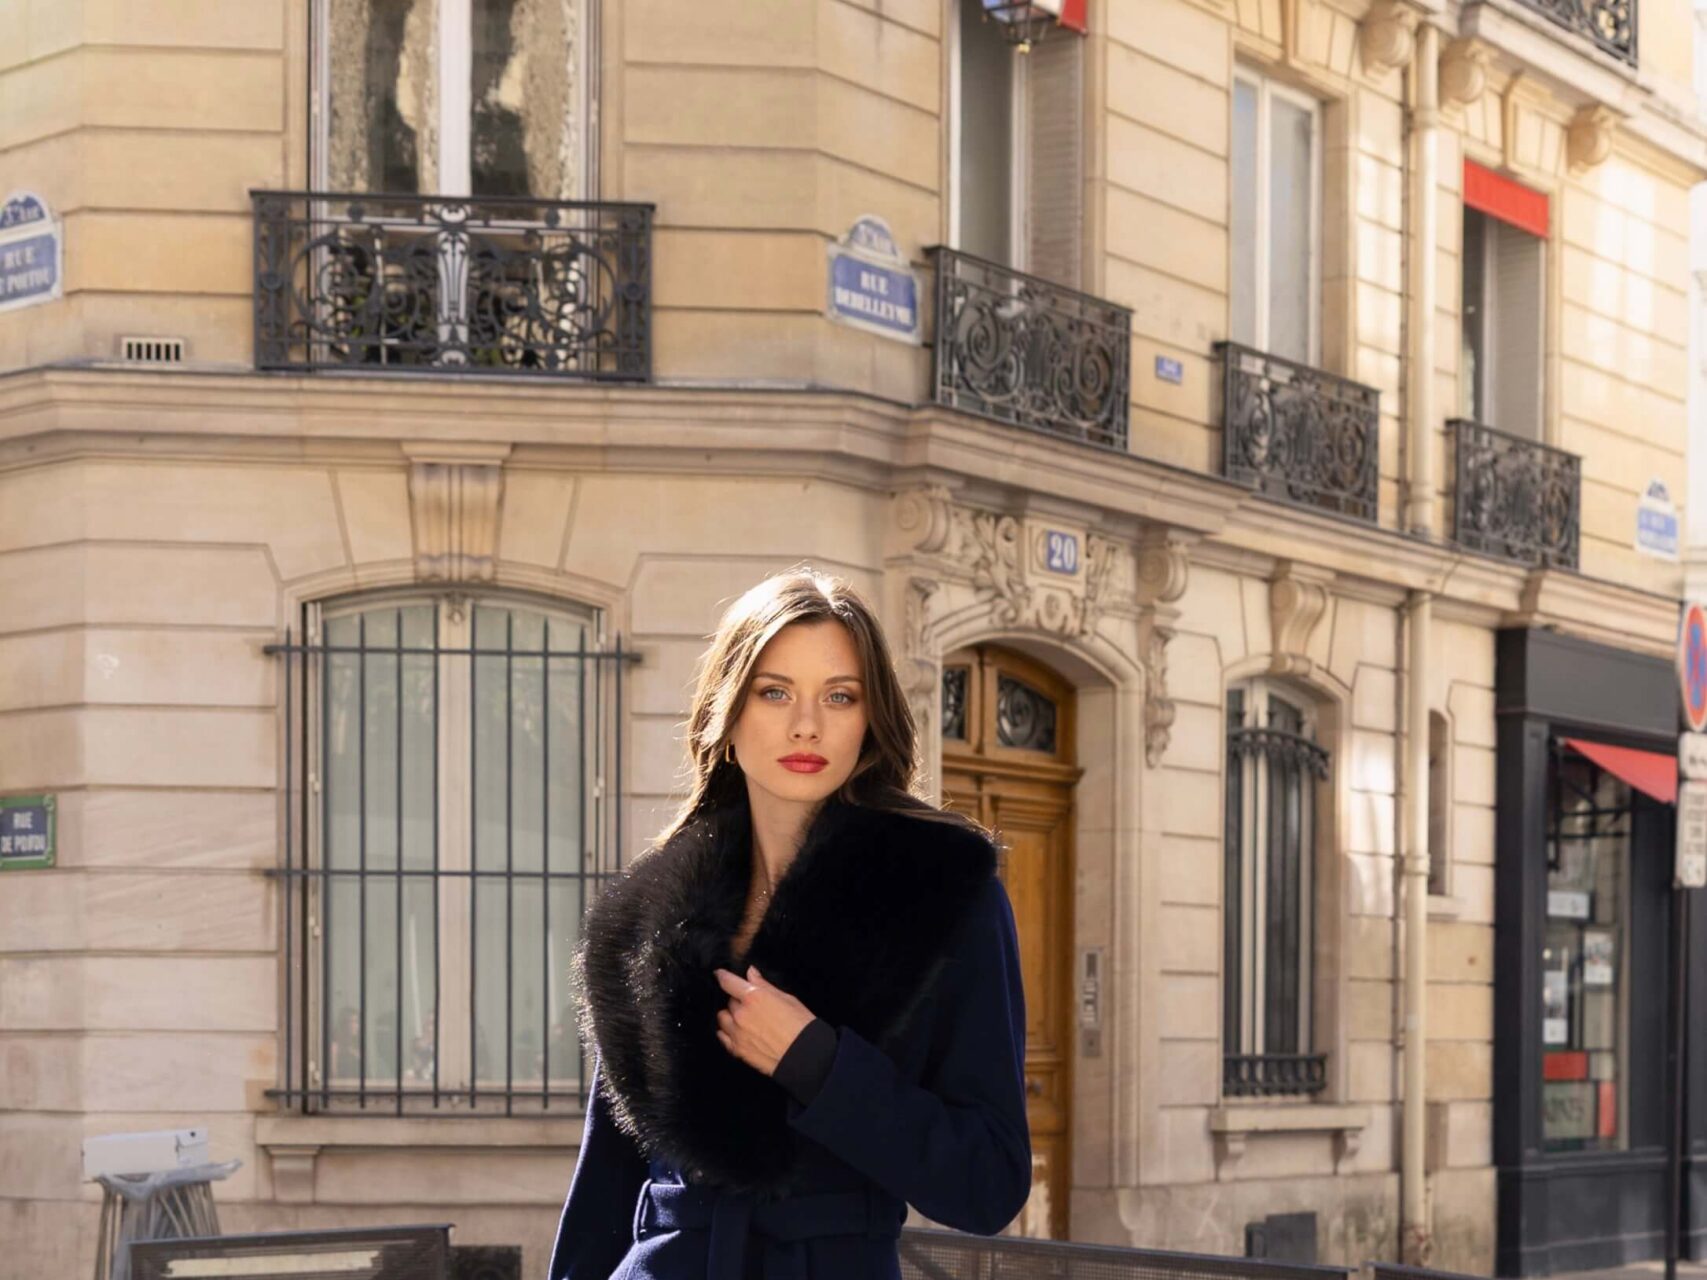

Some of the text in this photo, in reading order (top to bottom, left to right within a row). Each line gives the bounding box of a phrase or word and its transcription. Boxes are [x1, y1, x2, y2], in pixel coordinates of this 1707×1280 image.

[4, 246, 35, 270] RUE
[860, 270, 887, 296] RUE
[1050, 534, 1075, 571] 20
[13, 811, 33, 829] RUE
[1, 835, 13, 853] DE
